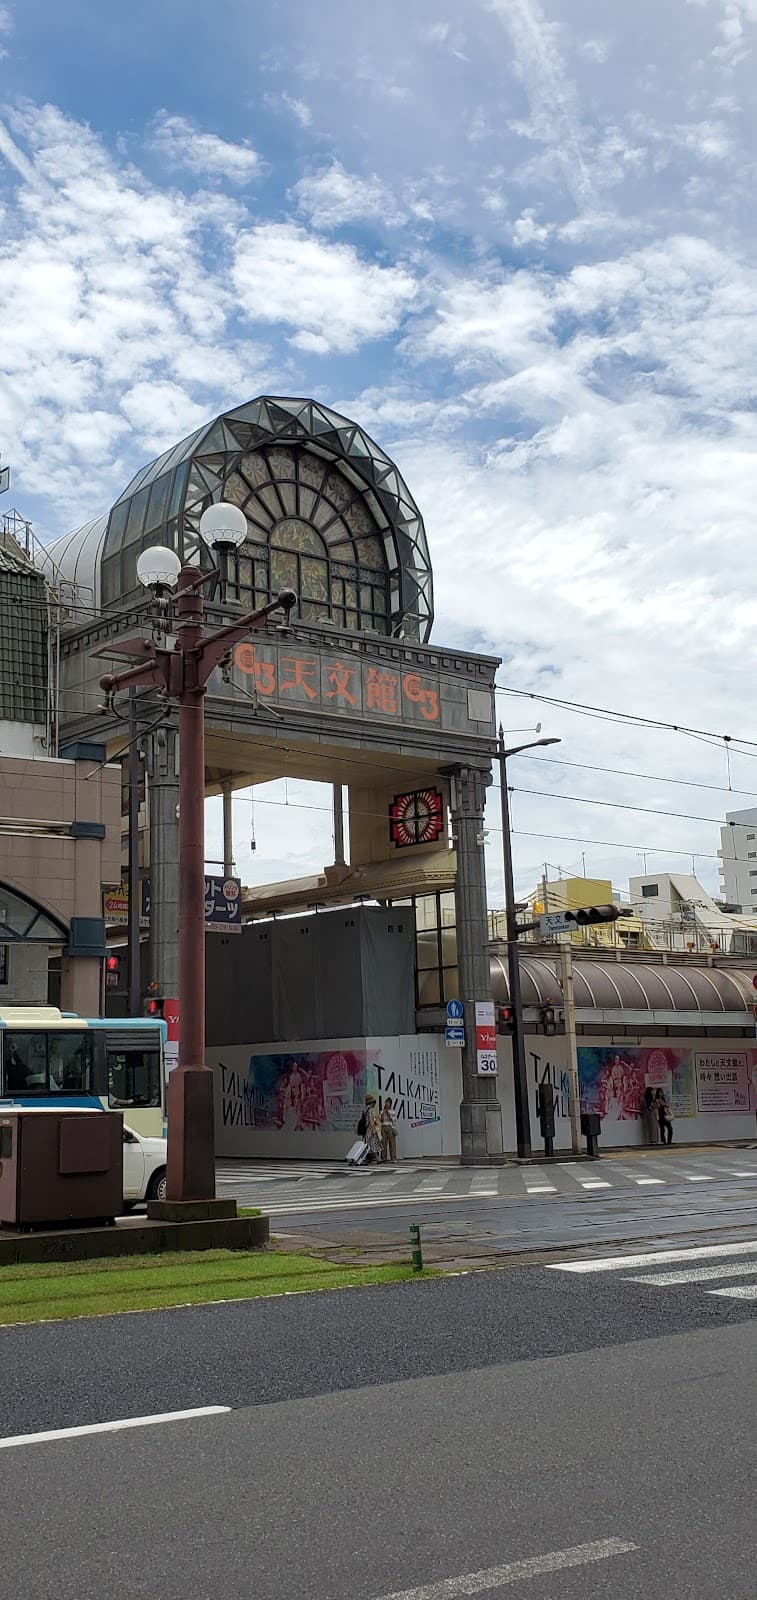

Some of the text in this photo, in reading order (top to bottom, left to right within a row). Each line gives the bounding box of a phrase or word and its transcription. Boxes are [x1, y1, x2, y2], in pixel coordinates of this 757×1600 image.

[279, 655, 398, 714] 天文館
[373, 1063, 439, 1104] TALKATIVE
[480, 1059, 496, 1072] 30
